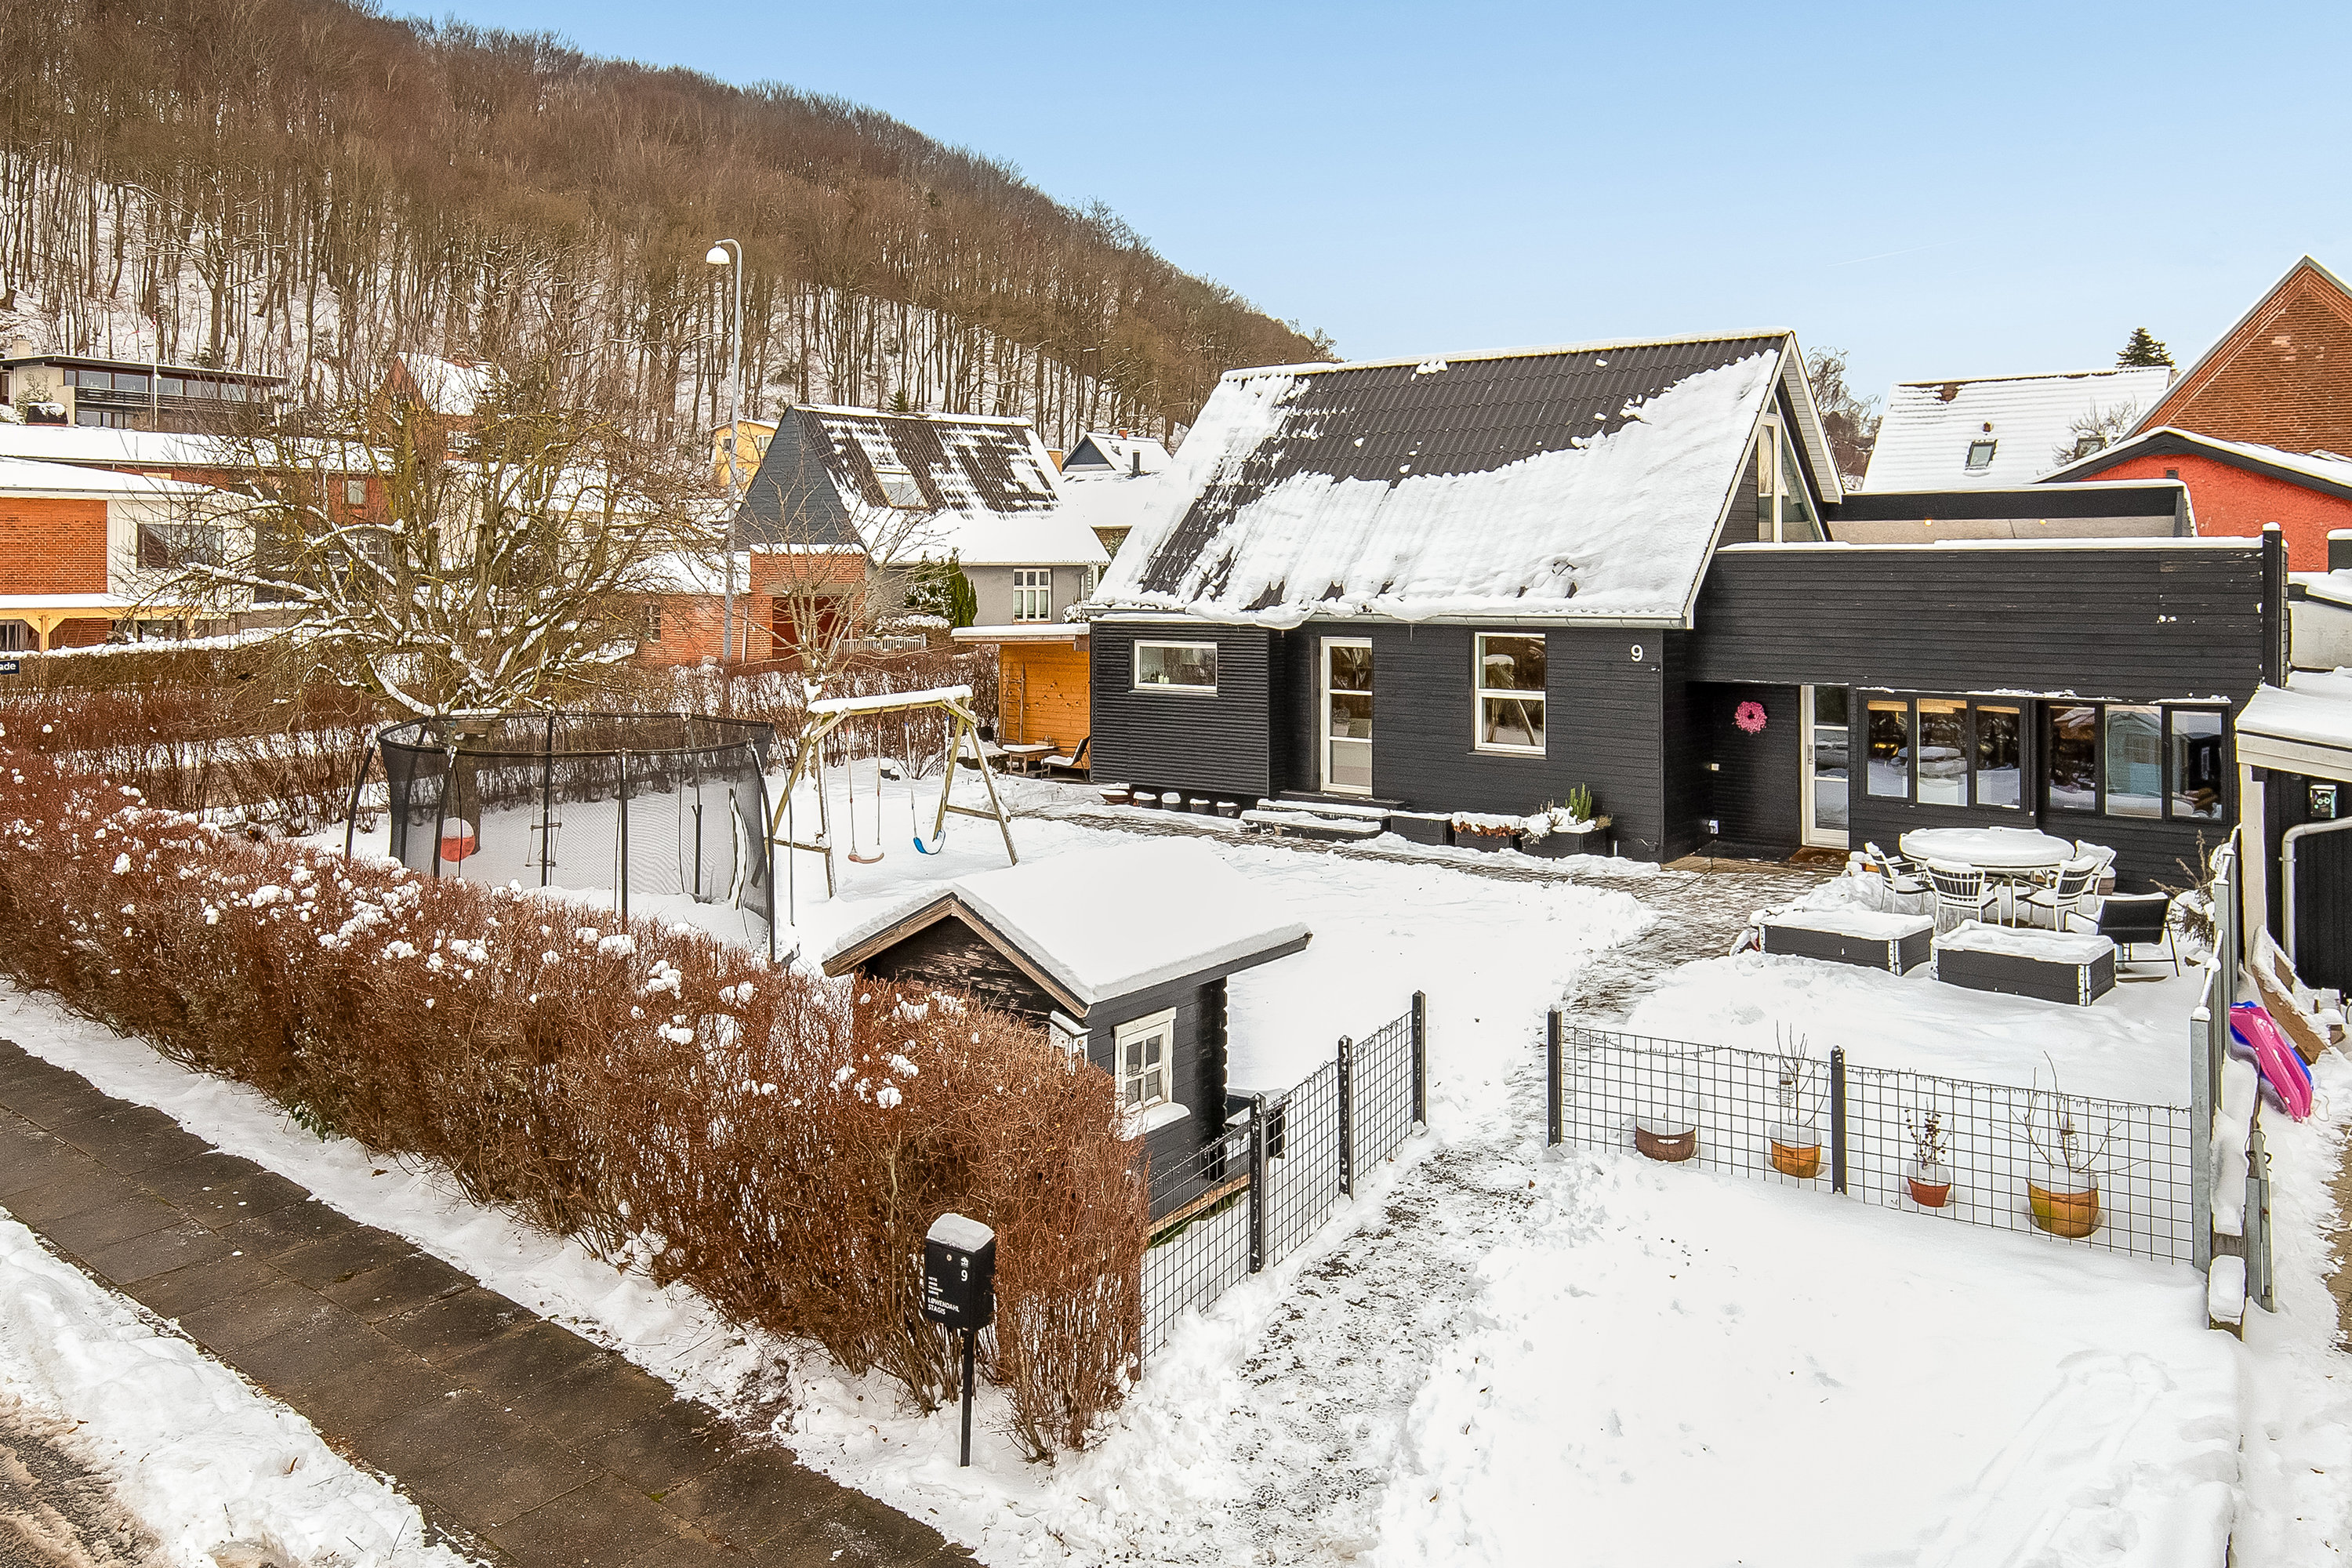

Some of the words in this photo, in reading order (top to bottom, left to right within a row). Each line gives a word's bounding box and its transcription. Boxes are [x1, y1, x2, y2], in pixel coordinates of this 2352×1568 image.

[1631, 644, 1643, 662] 9
[961, 1269, 968, 1282] 9
[927, 1297, 960, 1312] LØWENDAHL
[927, 1304, 946, 1315] STAGIS
